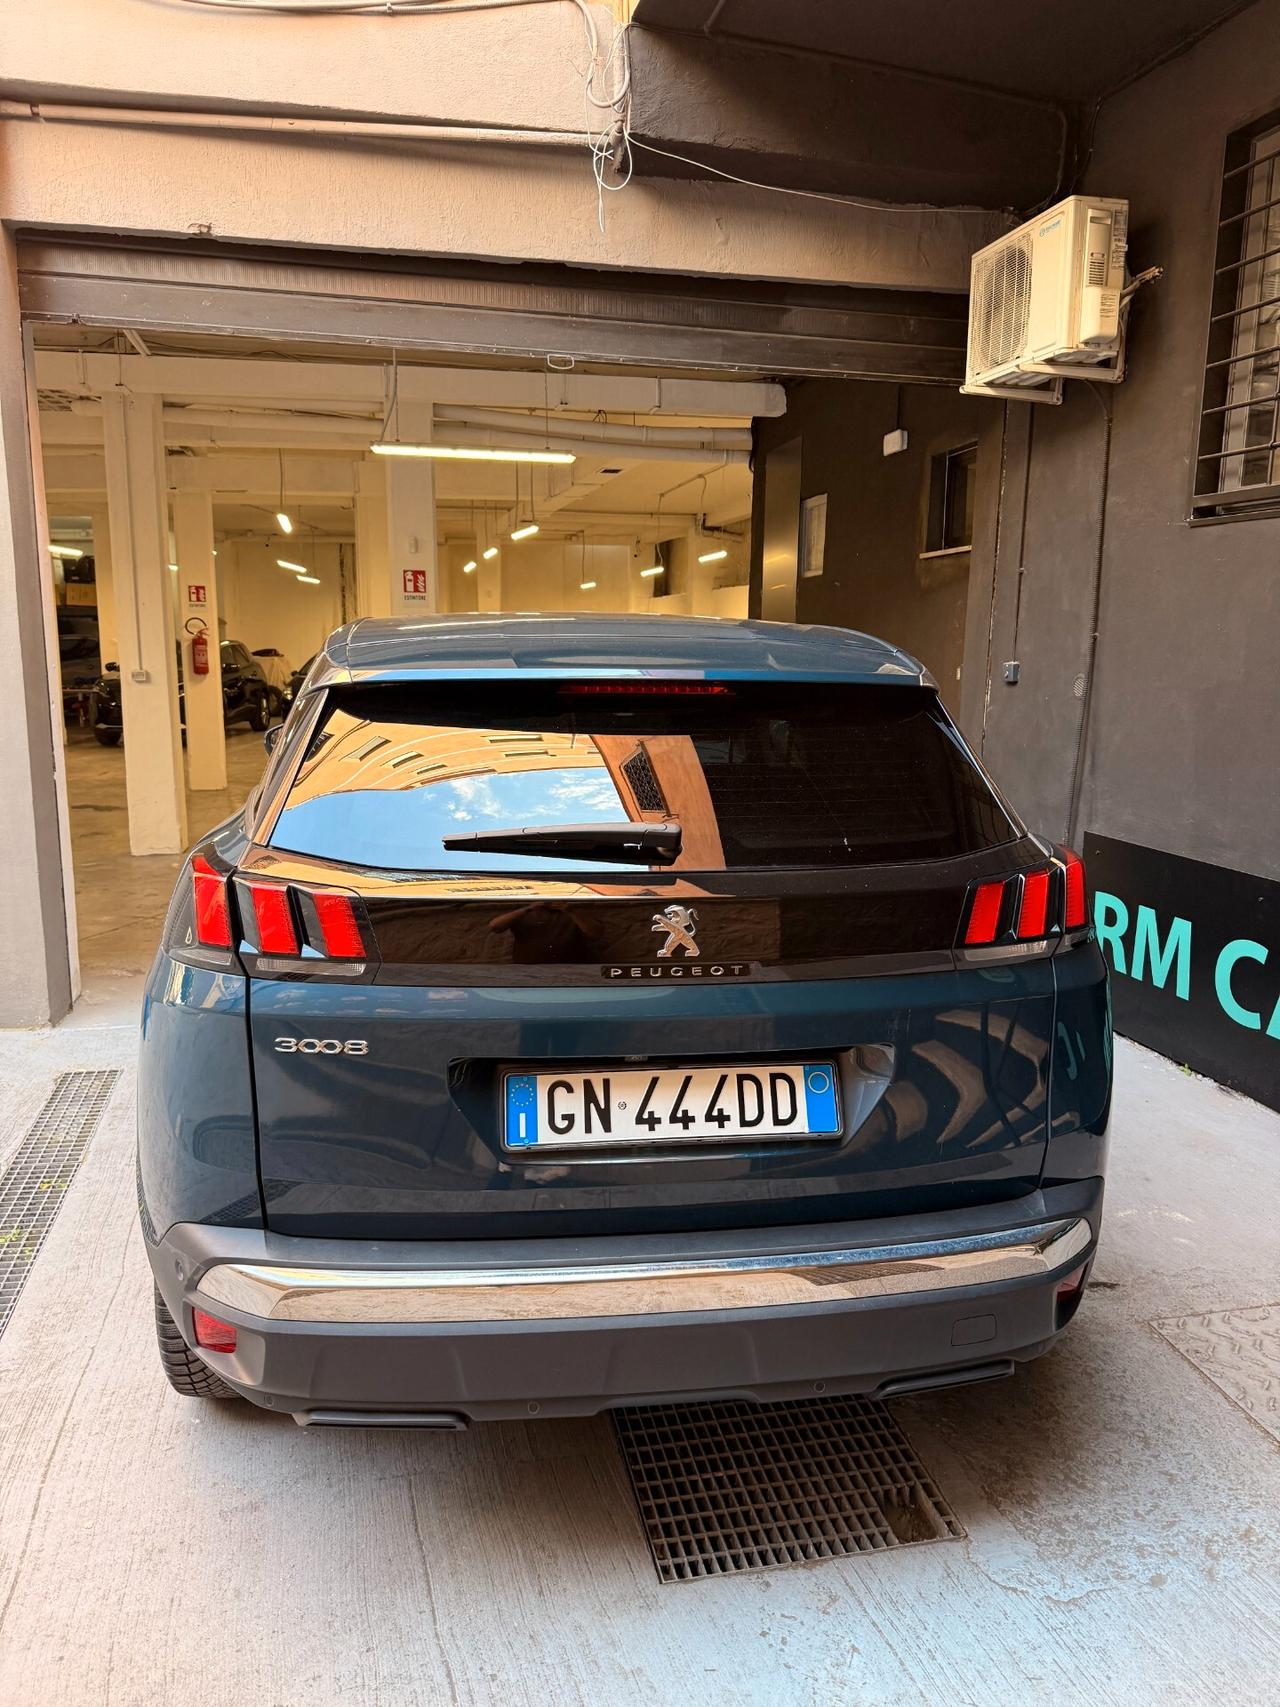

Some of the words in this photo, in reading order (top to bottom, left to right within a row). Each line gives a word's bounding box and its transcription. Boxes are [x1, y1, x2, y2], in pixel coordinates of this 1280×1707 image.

[610, 965, 743, 978] PEUGEOT
[1215, 939, 1280, 1041] C
[274, 1037, 369, 1055] 3008
[547, 1077, 612, 1135] GN
[635, 1072, 798, 1132] 444DD
[519, 1113, 527, 1138] I
